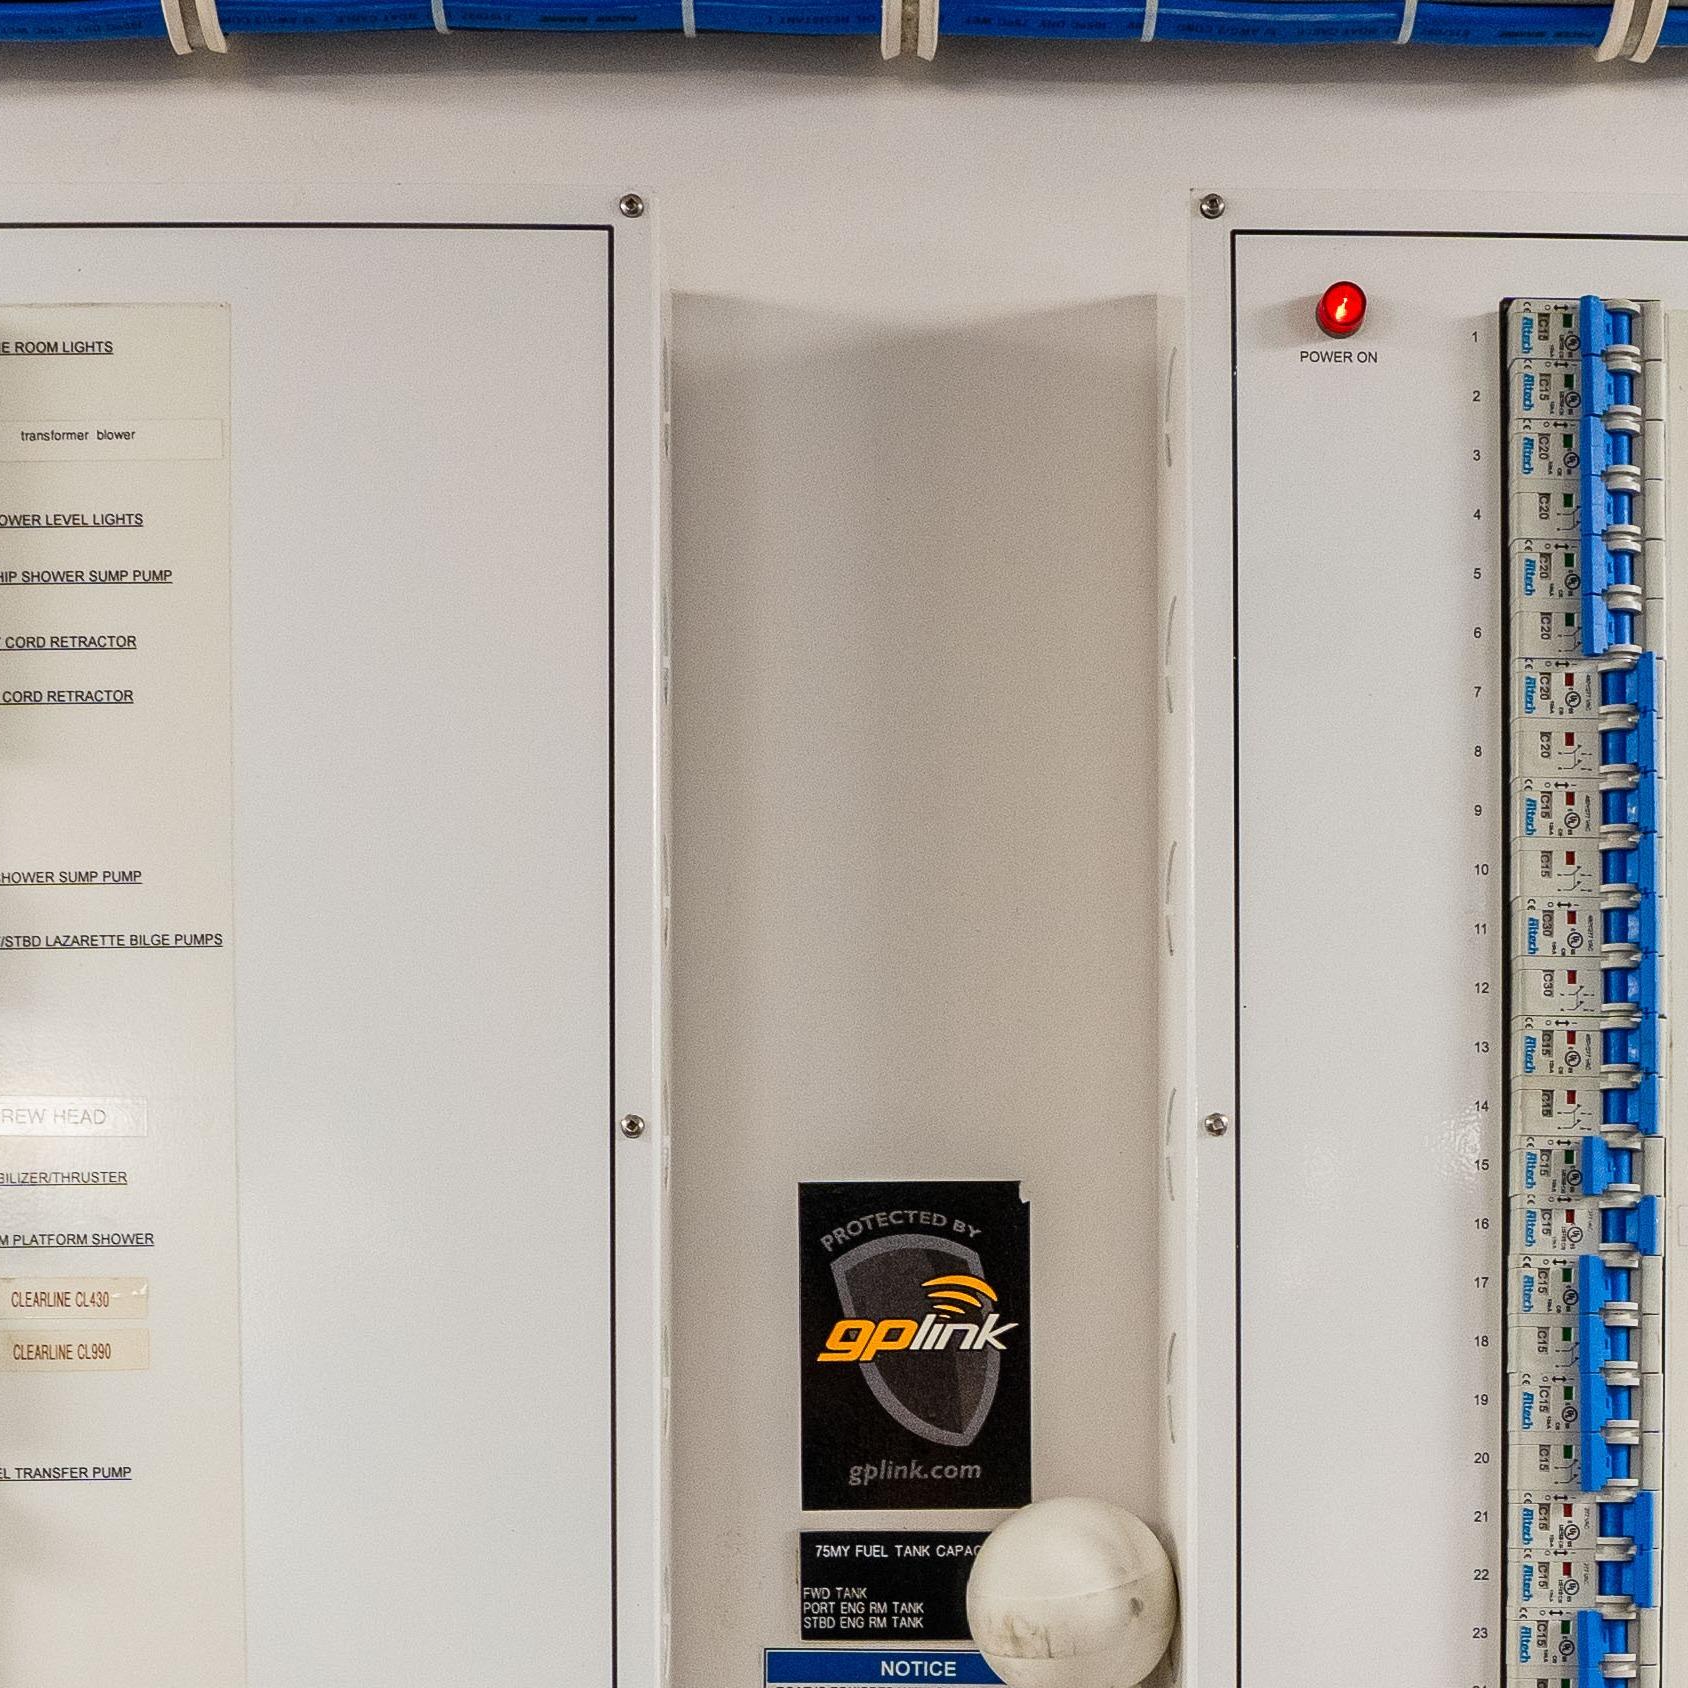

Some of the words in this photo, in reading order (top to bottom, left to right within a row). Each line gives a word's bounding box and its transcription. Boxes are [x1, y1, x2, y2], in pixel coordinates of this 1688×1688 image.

[14, 341, 59, 355] ROOM
[62, 340, 114, 354] LIGHTS
[1299, 350, 1353, 363] POWER
[1356, 351, 1378, 364] ON
[20, 429, 90, 442] transformer
[96, 429, 136, 441] blower
[45, 513, 86, 527] LEVEL
[92, 512, 144, 526] LIGHTS
[21, 570, 85, 584] SHOWER
[88, 569, 129, 583] SUMP
[132, 569, 173, 583] PUMP
[4, 635, 46, 650] CORD
[49, 635, 137, 648] RETRACTOR
[58, 870, 99, 884] SUMP
[102, 870, 142, 883] PUMP
[45, 934, 126, 947] LAZARETTE
[129, 933, 171, 947] BILGE
[174, 933, 223, 946] PUMPS
[53, 1107, 108, 1124] HEAD
[820, 1210, 947, 1252] PROTECTED
[953, 1219, 982, 1239] BY
[12, 1233, 88, 1246] PLATFORM
[91, 1232, 155, 1247] SHOWER
[817, 1313, 1019, 1362] gplink
[10, 1344, 73, 1361] CLEARLINE
[77, 1344, 112, 1361] CL990
[14, 1466, 89, 1479] TRANSFER
[92, 1466, 132, 1479] PUMP
[848, 1459, 982, 1487] gplink.com
[815, 1544, 851, 1559] 75MY
[855, 1544, 888, 1559] FUEL
[895, 1544, 930, 1558] TANK
[881, 1660, 957, 1677] NOTICE
